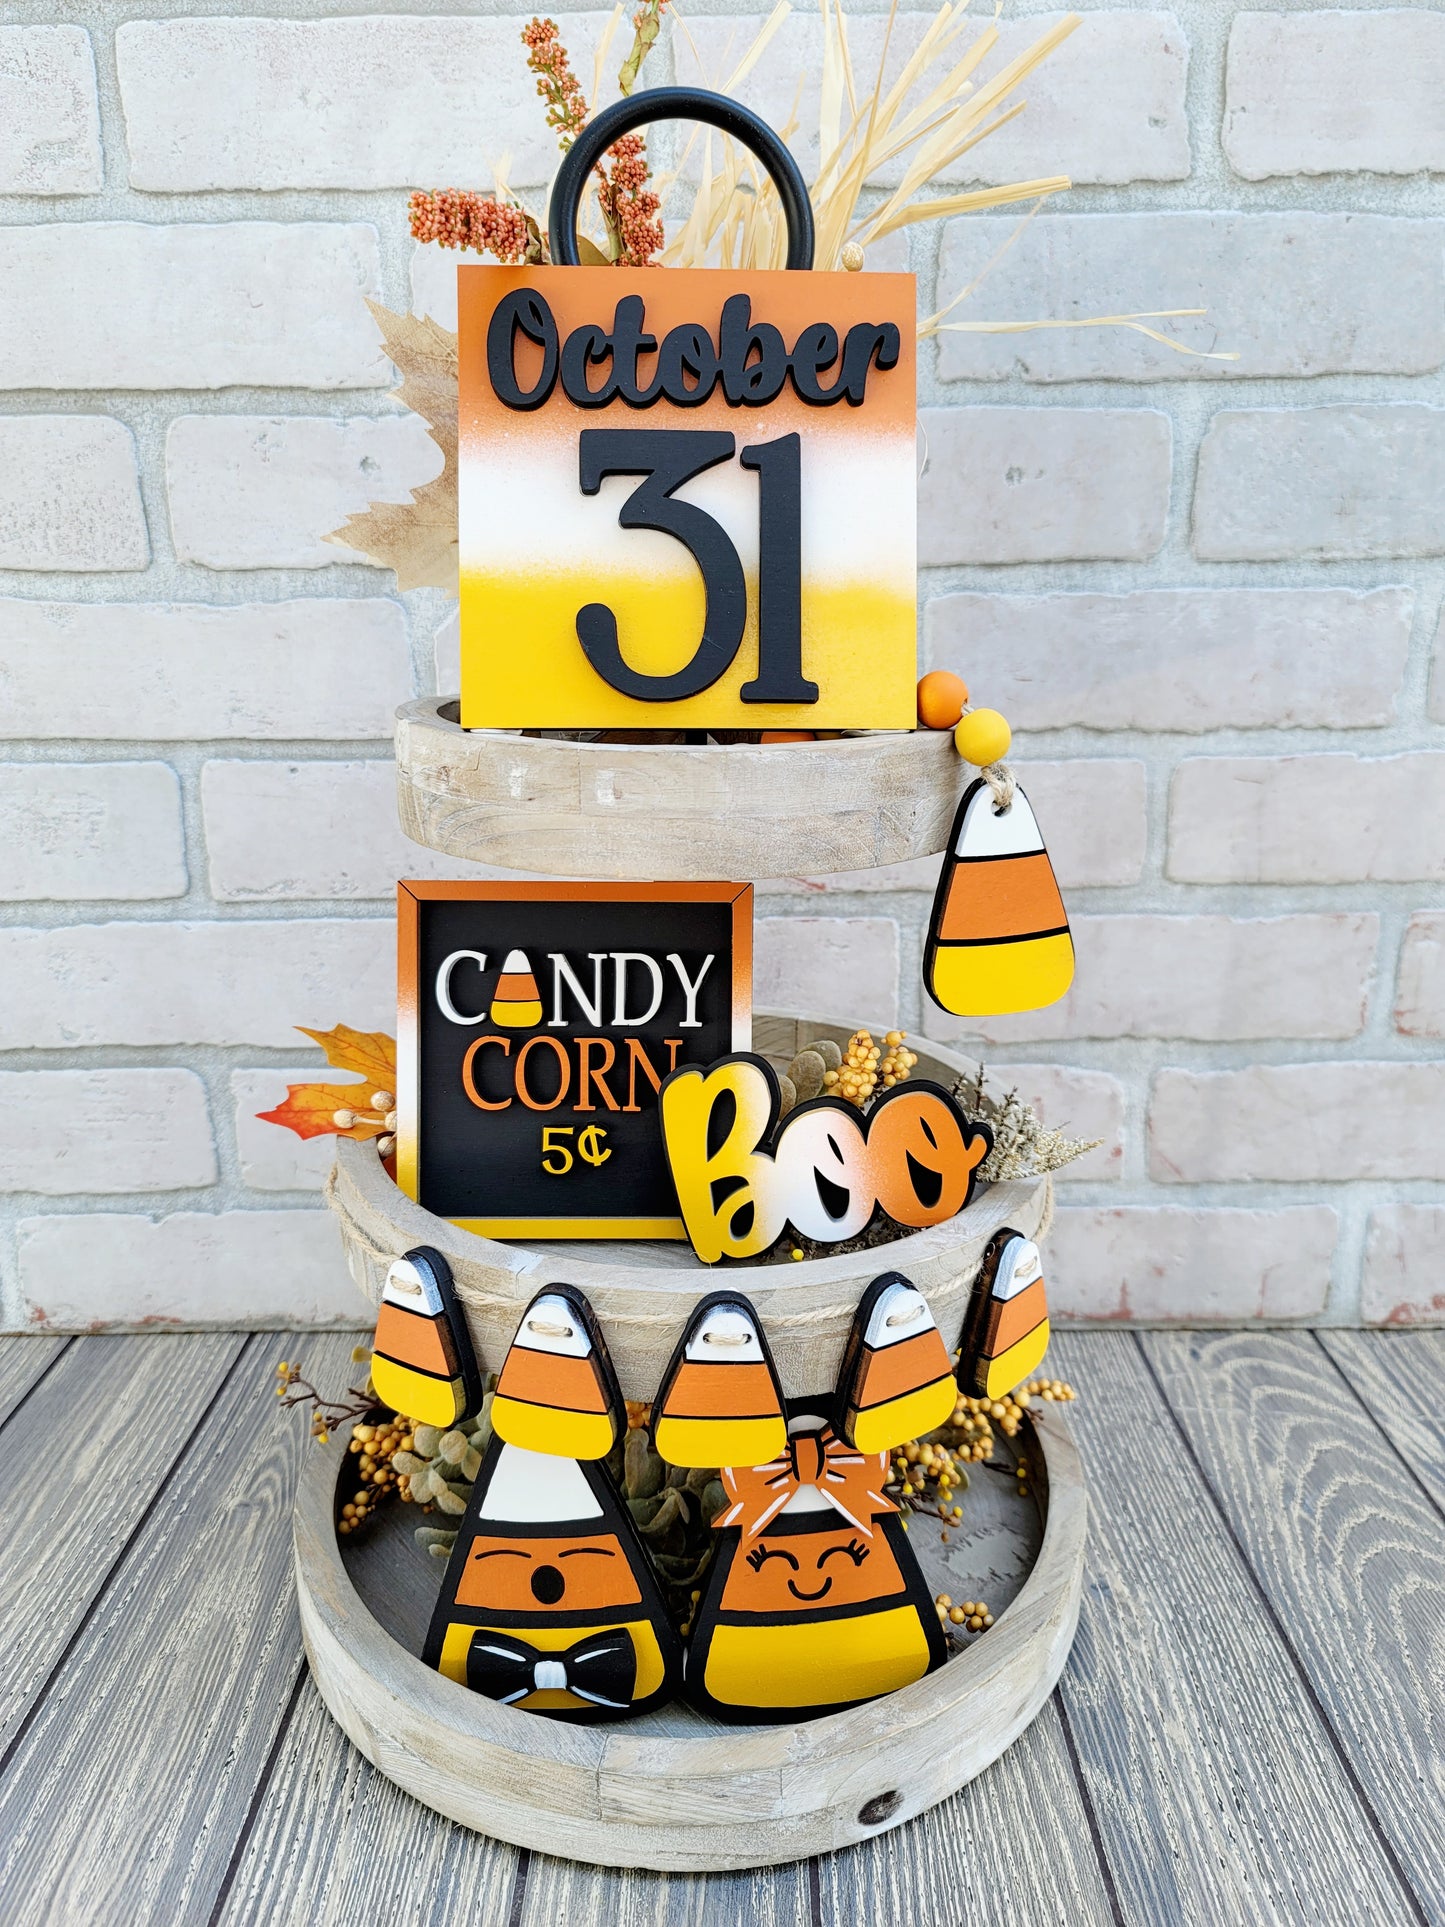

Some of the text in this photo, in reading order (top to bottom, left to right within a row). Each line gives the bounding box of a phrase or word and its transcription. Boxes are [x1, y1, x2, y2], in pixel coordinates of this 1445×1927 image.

[487, 288, 900, 411] October
[576, 429, 819, 704] 31
[461, 1035, 684, 1112] CORN
[541, 1124, 613, 1175] 5¢
